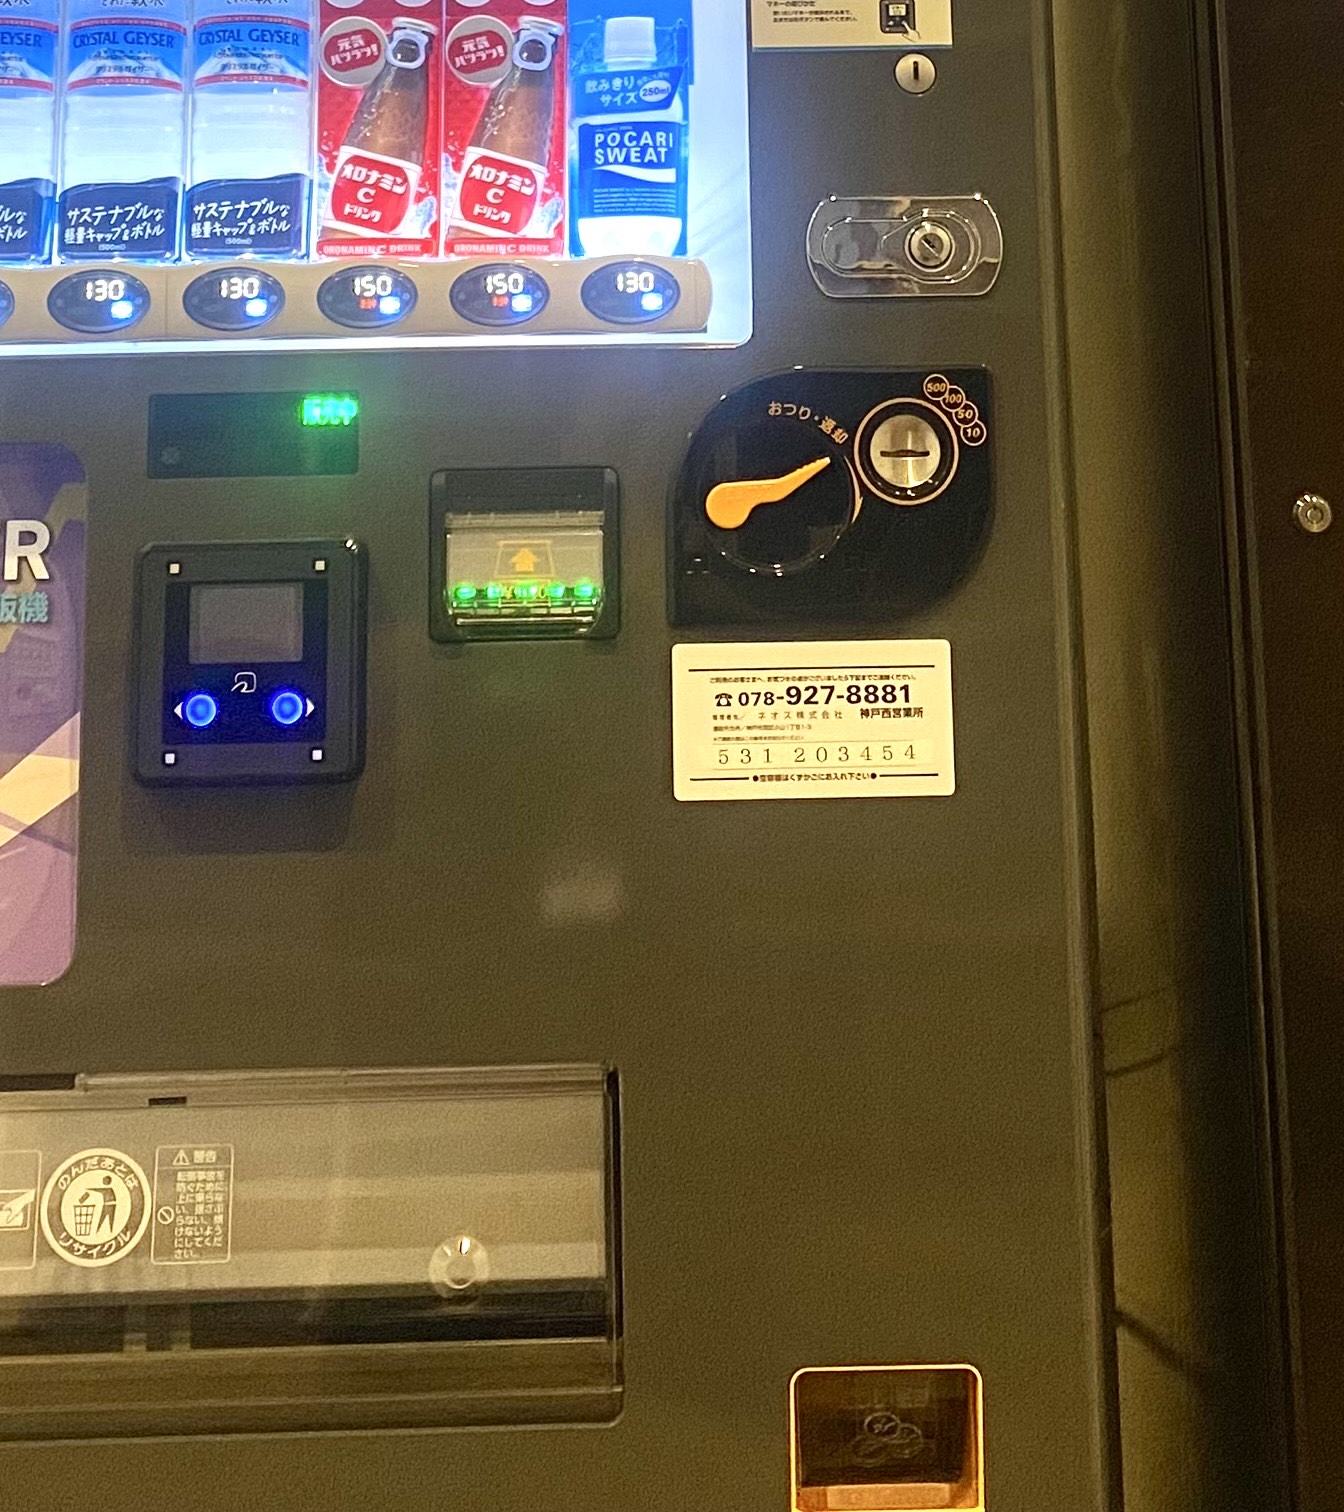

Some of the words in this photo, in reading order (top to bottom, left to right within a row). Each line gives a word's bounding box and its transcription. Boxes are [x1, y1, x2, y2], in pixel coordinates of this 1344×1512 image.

[199, 29, 248, 46] CRYSTAL
[252, 28, 300, 47] GEYSER
[338, 35, 364, 51] 元気
[600, 93, 638, 106] サイズ
[341, 164, 407, 195] オロナミン
[470, 164, 534, 195] オロナミン
[67, 202, 165, 225] サステナブルな
[344, 204, 382, 223] ドリンク
[519, 244, 549, 254] DRINK
[219, 277, 259, 299] 130
[352, 276, 392, 296] 150
[486, 273, 524, 295] 150
[926, 382, 946, 392] 500
[957, 410, 973, 418] 50
[966, 428, 981, 437] 10
[738, 684, 911, 707] 078-927-8881
[59, 1230, 131, 1259] リサイクル
